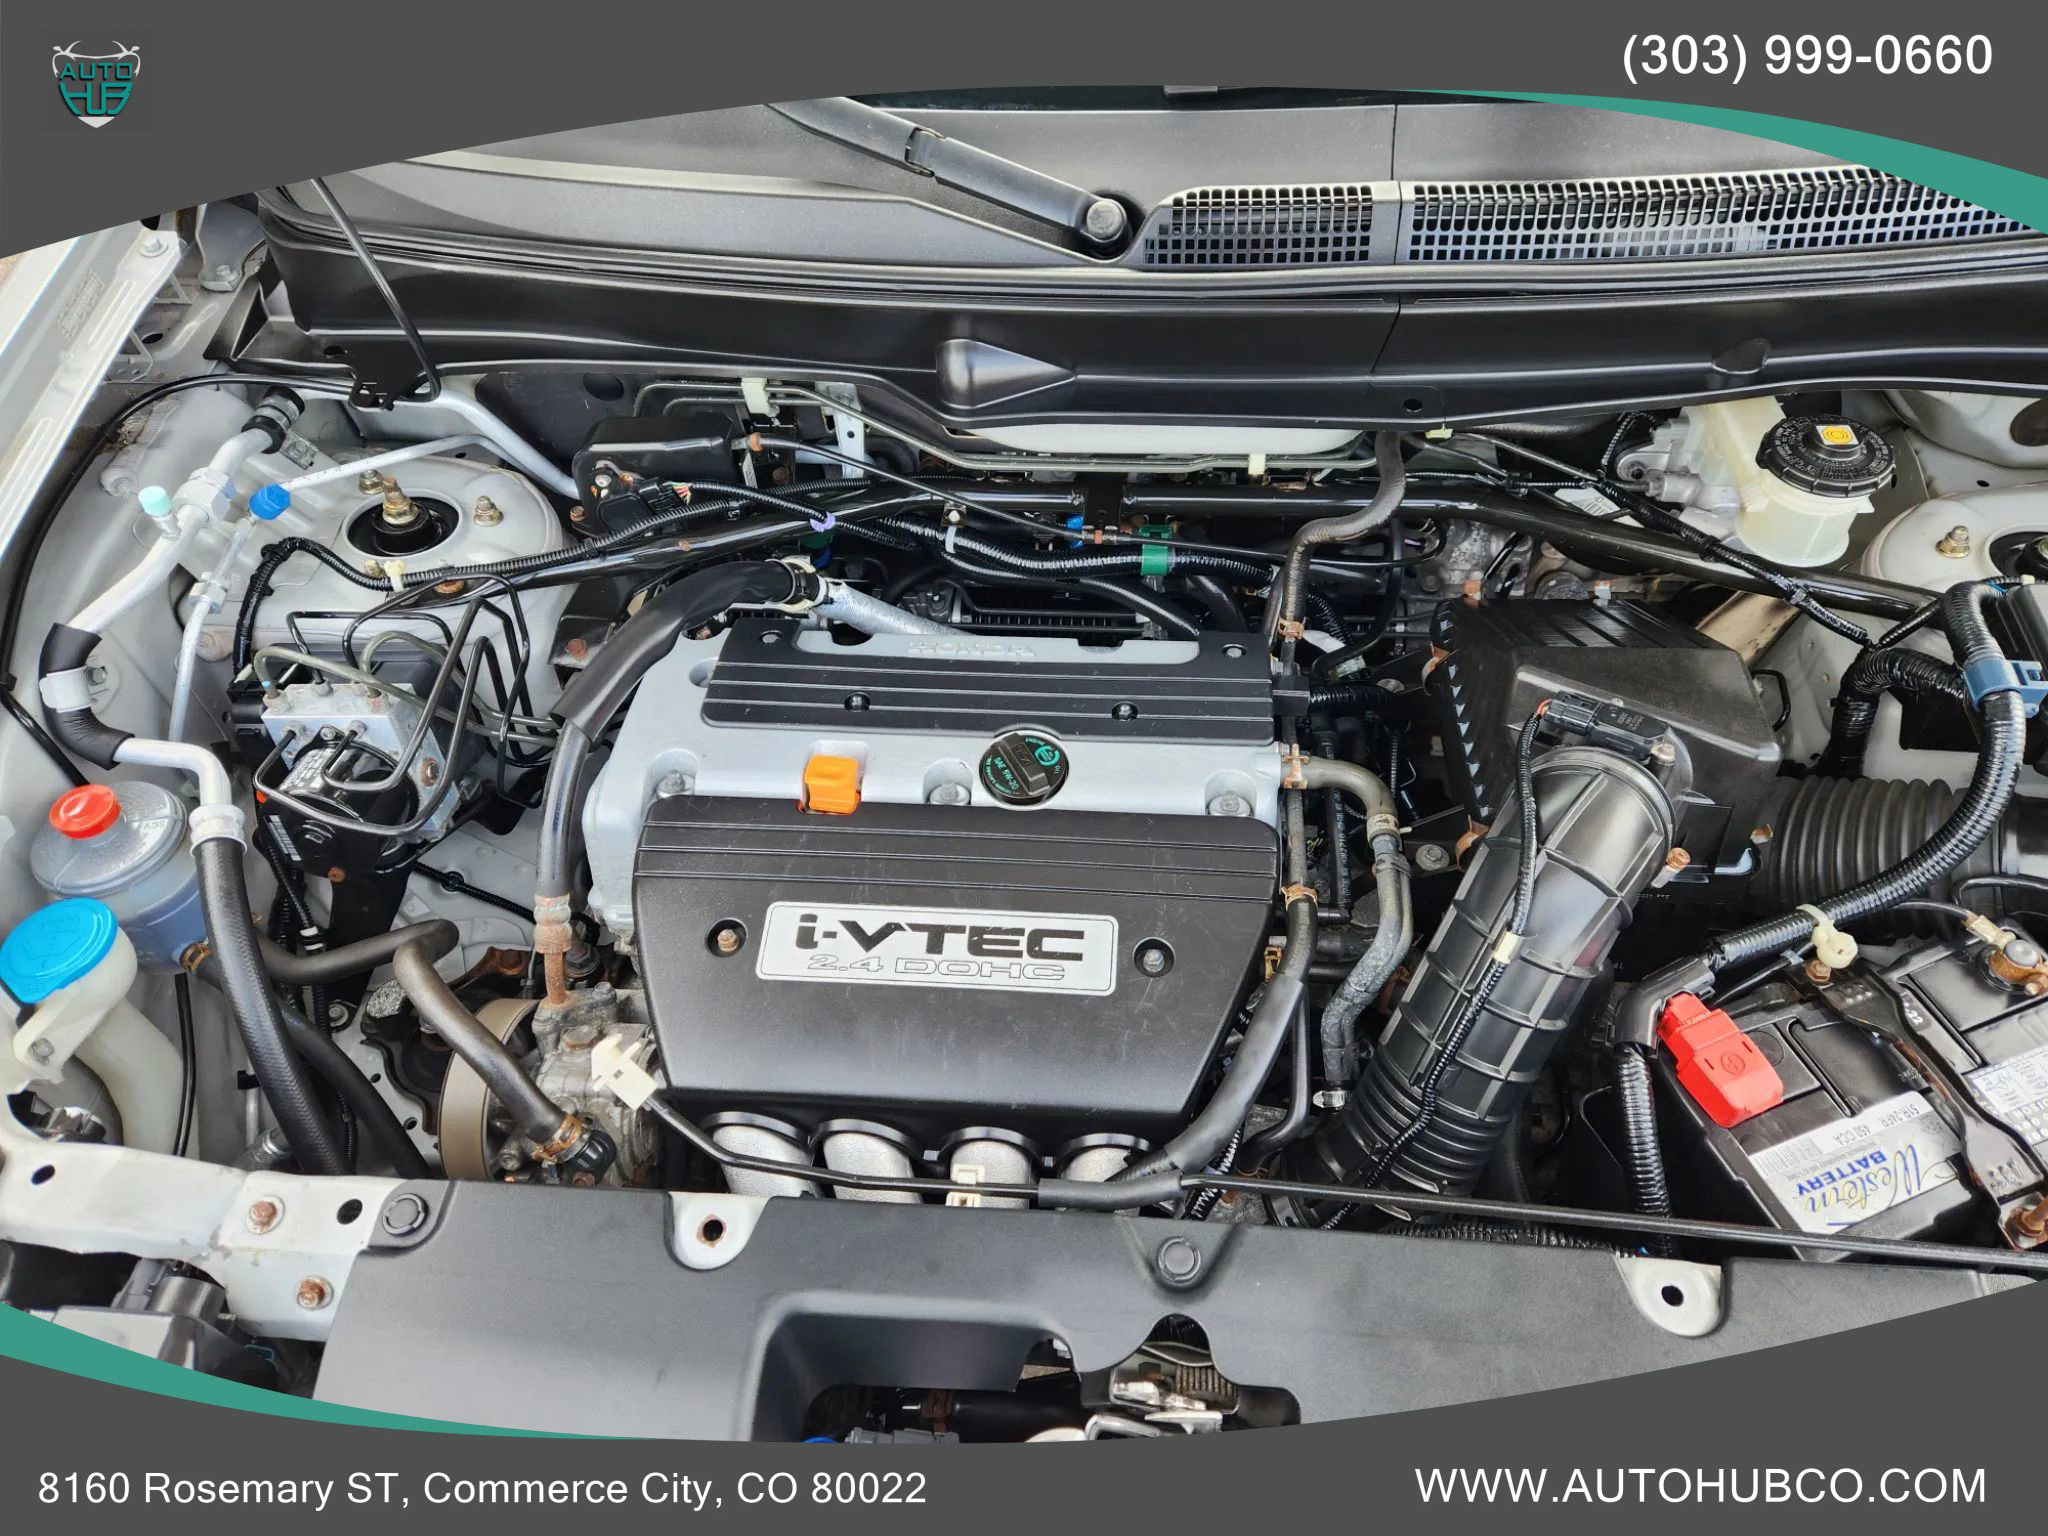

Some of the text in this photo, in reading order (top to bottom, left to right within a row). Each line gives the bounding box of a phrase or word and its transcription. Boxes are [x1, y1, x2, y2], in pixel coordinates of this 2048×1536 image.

[906, 641, 1035, 657] HONDA
[795, 912, 1085, 962] i-VTEC
[808, 953, 1066, 981] 2.4 DOHC
[1833, 1129, 1853, 1146] CCA
[1796, 1150, 1887, 1197] BATTERY
[1804, 1143, 1957, 1213] Western
